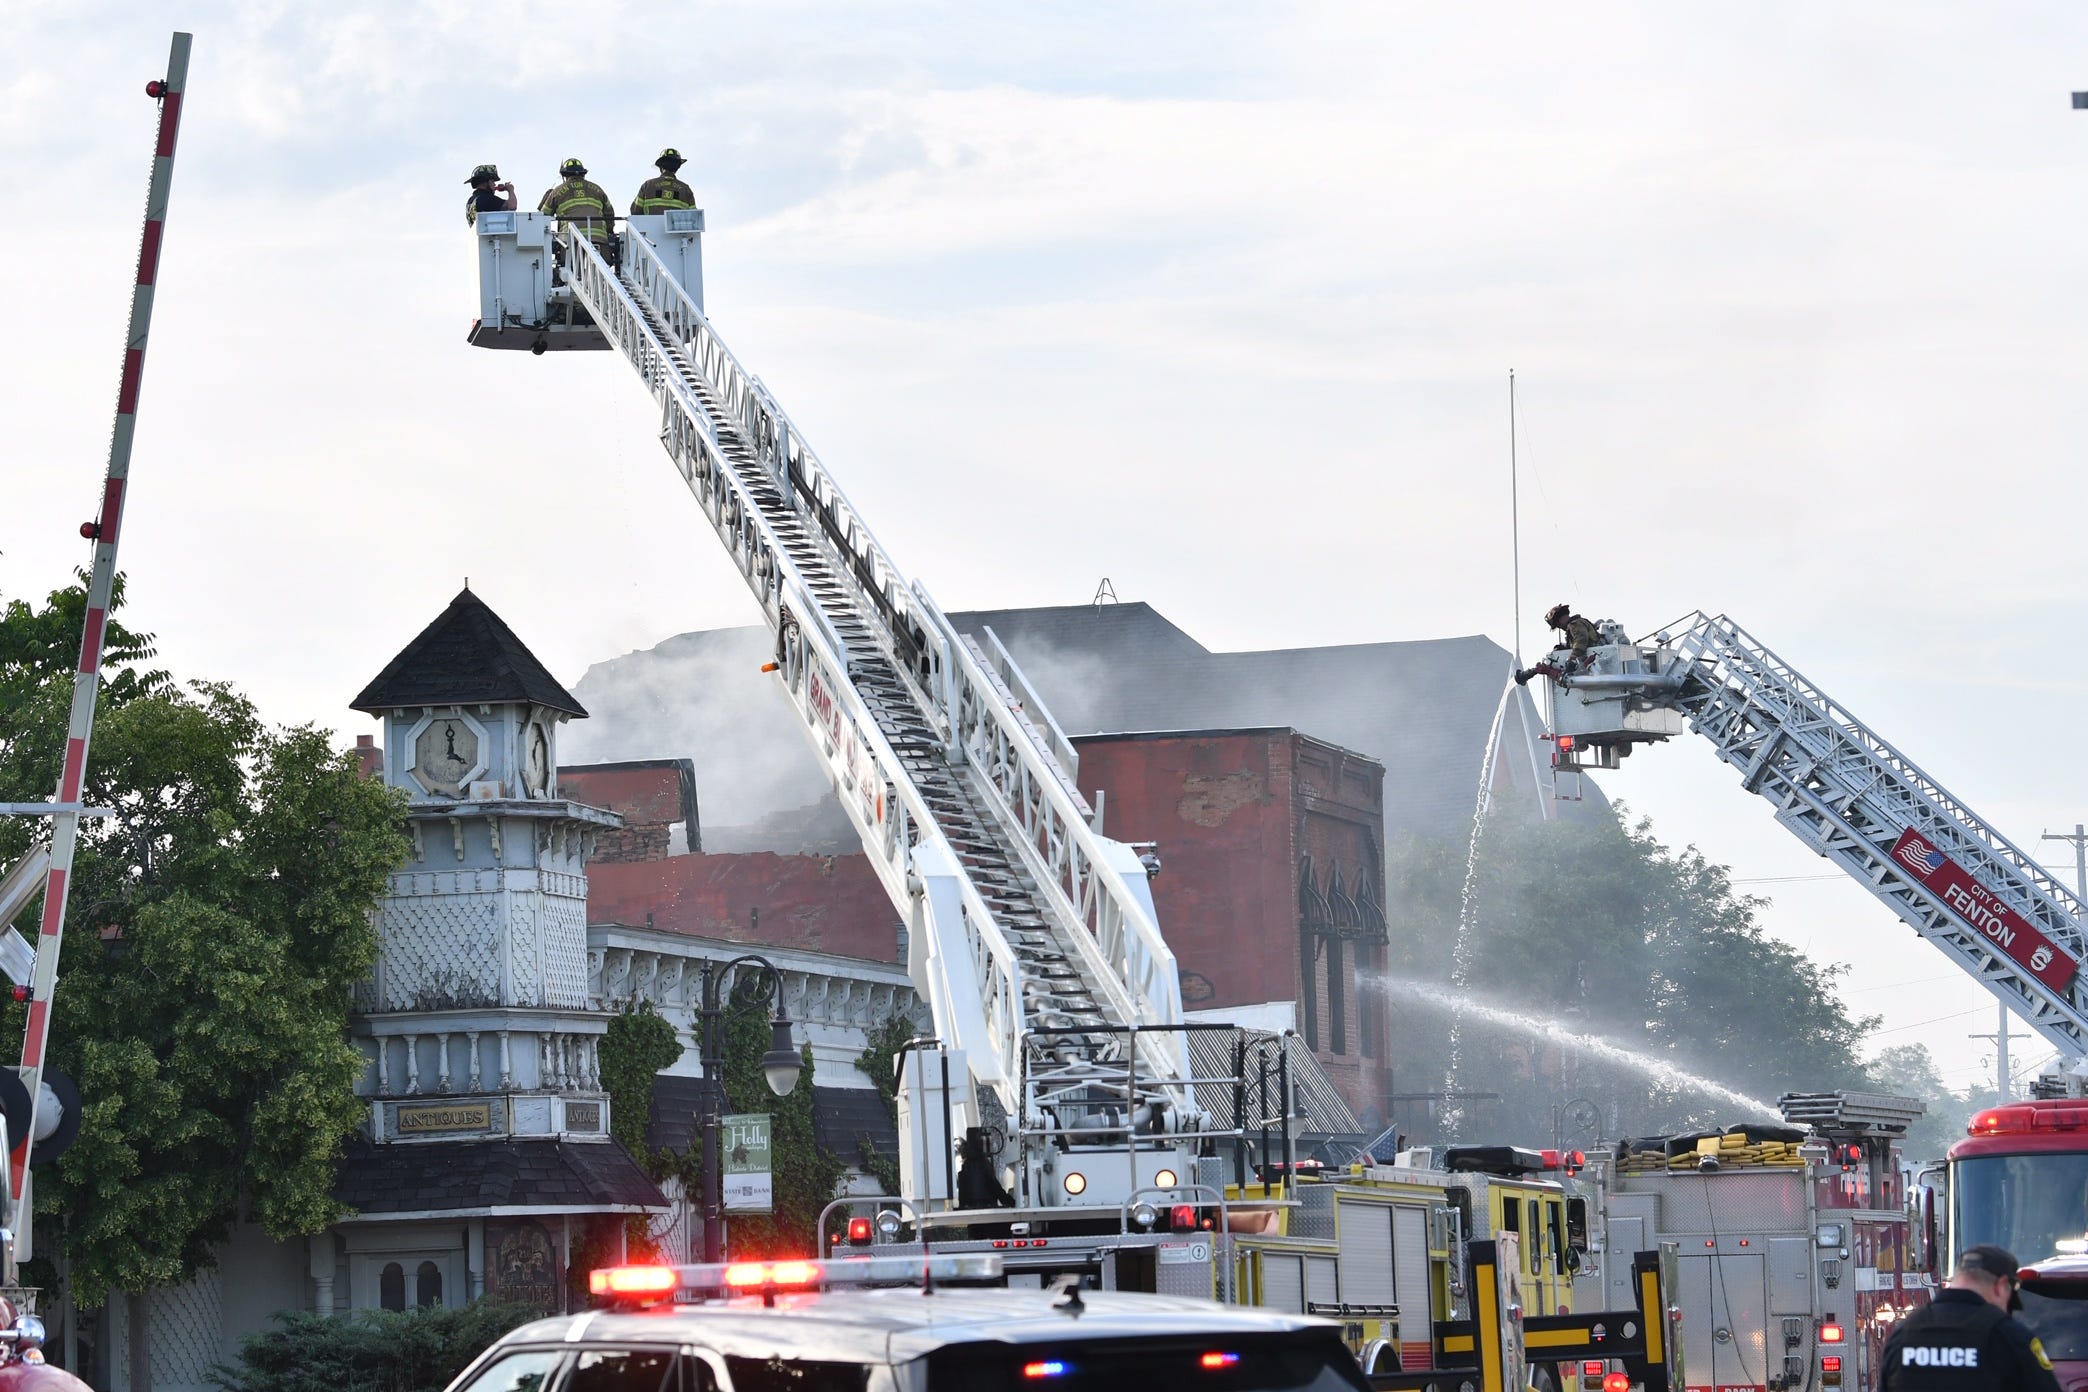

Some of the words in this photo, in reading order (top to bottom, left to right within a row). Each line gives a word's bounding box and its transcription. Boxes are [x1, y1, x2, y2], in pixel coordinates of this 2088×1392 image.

[810, 672, 832, 725] GRAND
[1971, 884, 1993, 904] CITY
[1993, 902, 2008, 915] OF
[1944, 883, 2016, 948] FENTON
[401, 1110, 484, 1128] ANTIQUES
[724, 1125, 768, 1152] Holly
[1902, 1346, 1978, 1367] POLICE
